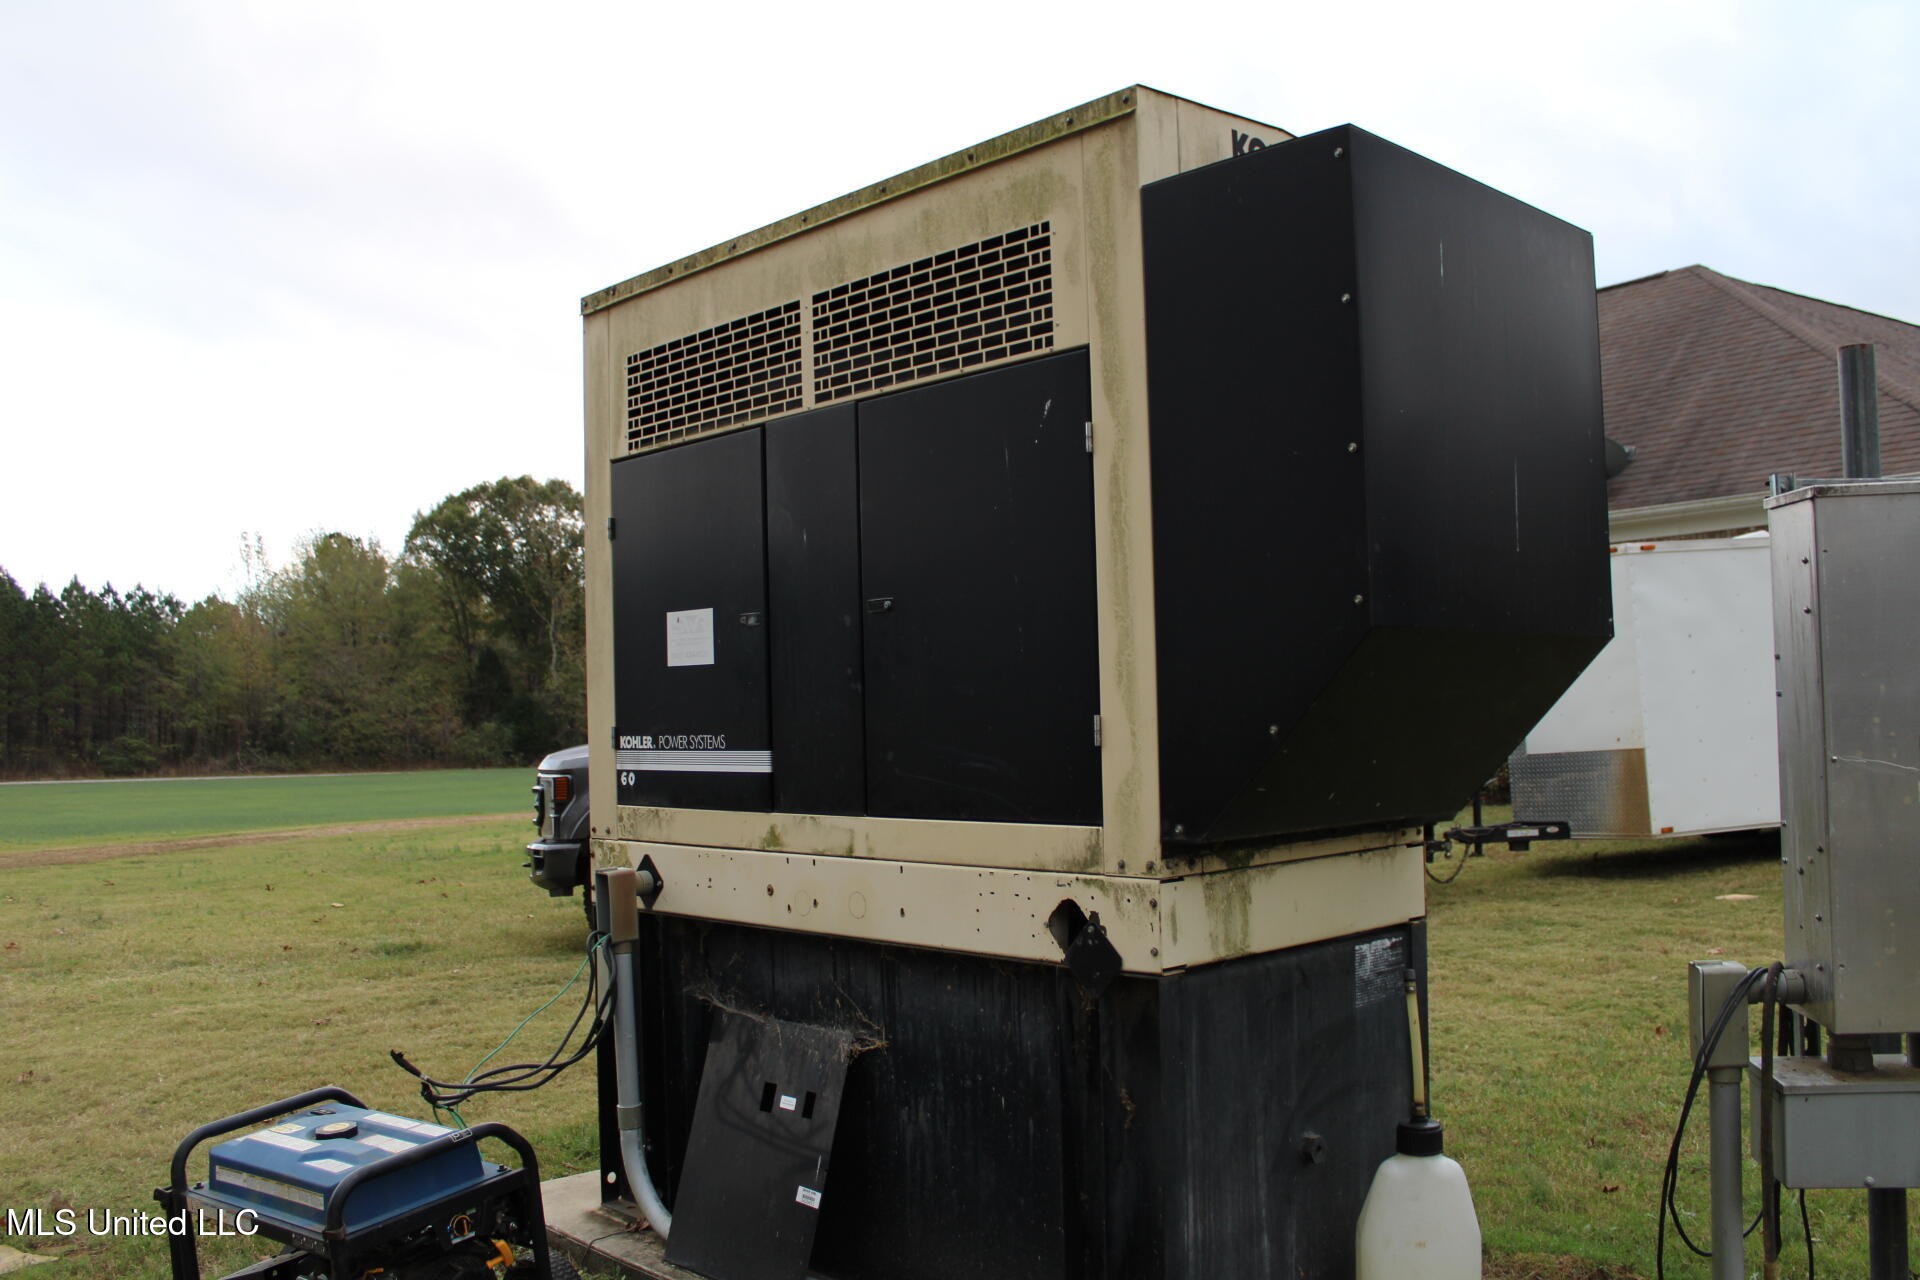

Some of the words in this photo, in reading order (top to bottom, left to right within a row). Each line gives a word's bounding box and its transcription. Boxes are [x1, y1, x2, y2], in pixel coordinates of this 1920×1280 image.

[658, 735, 688, 750] POWER
[689, 734, 726, 750] SYSTEMS
[620, 771, 635, 786] 60
